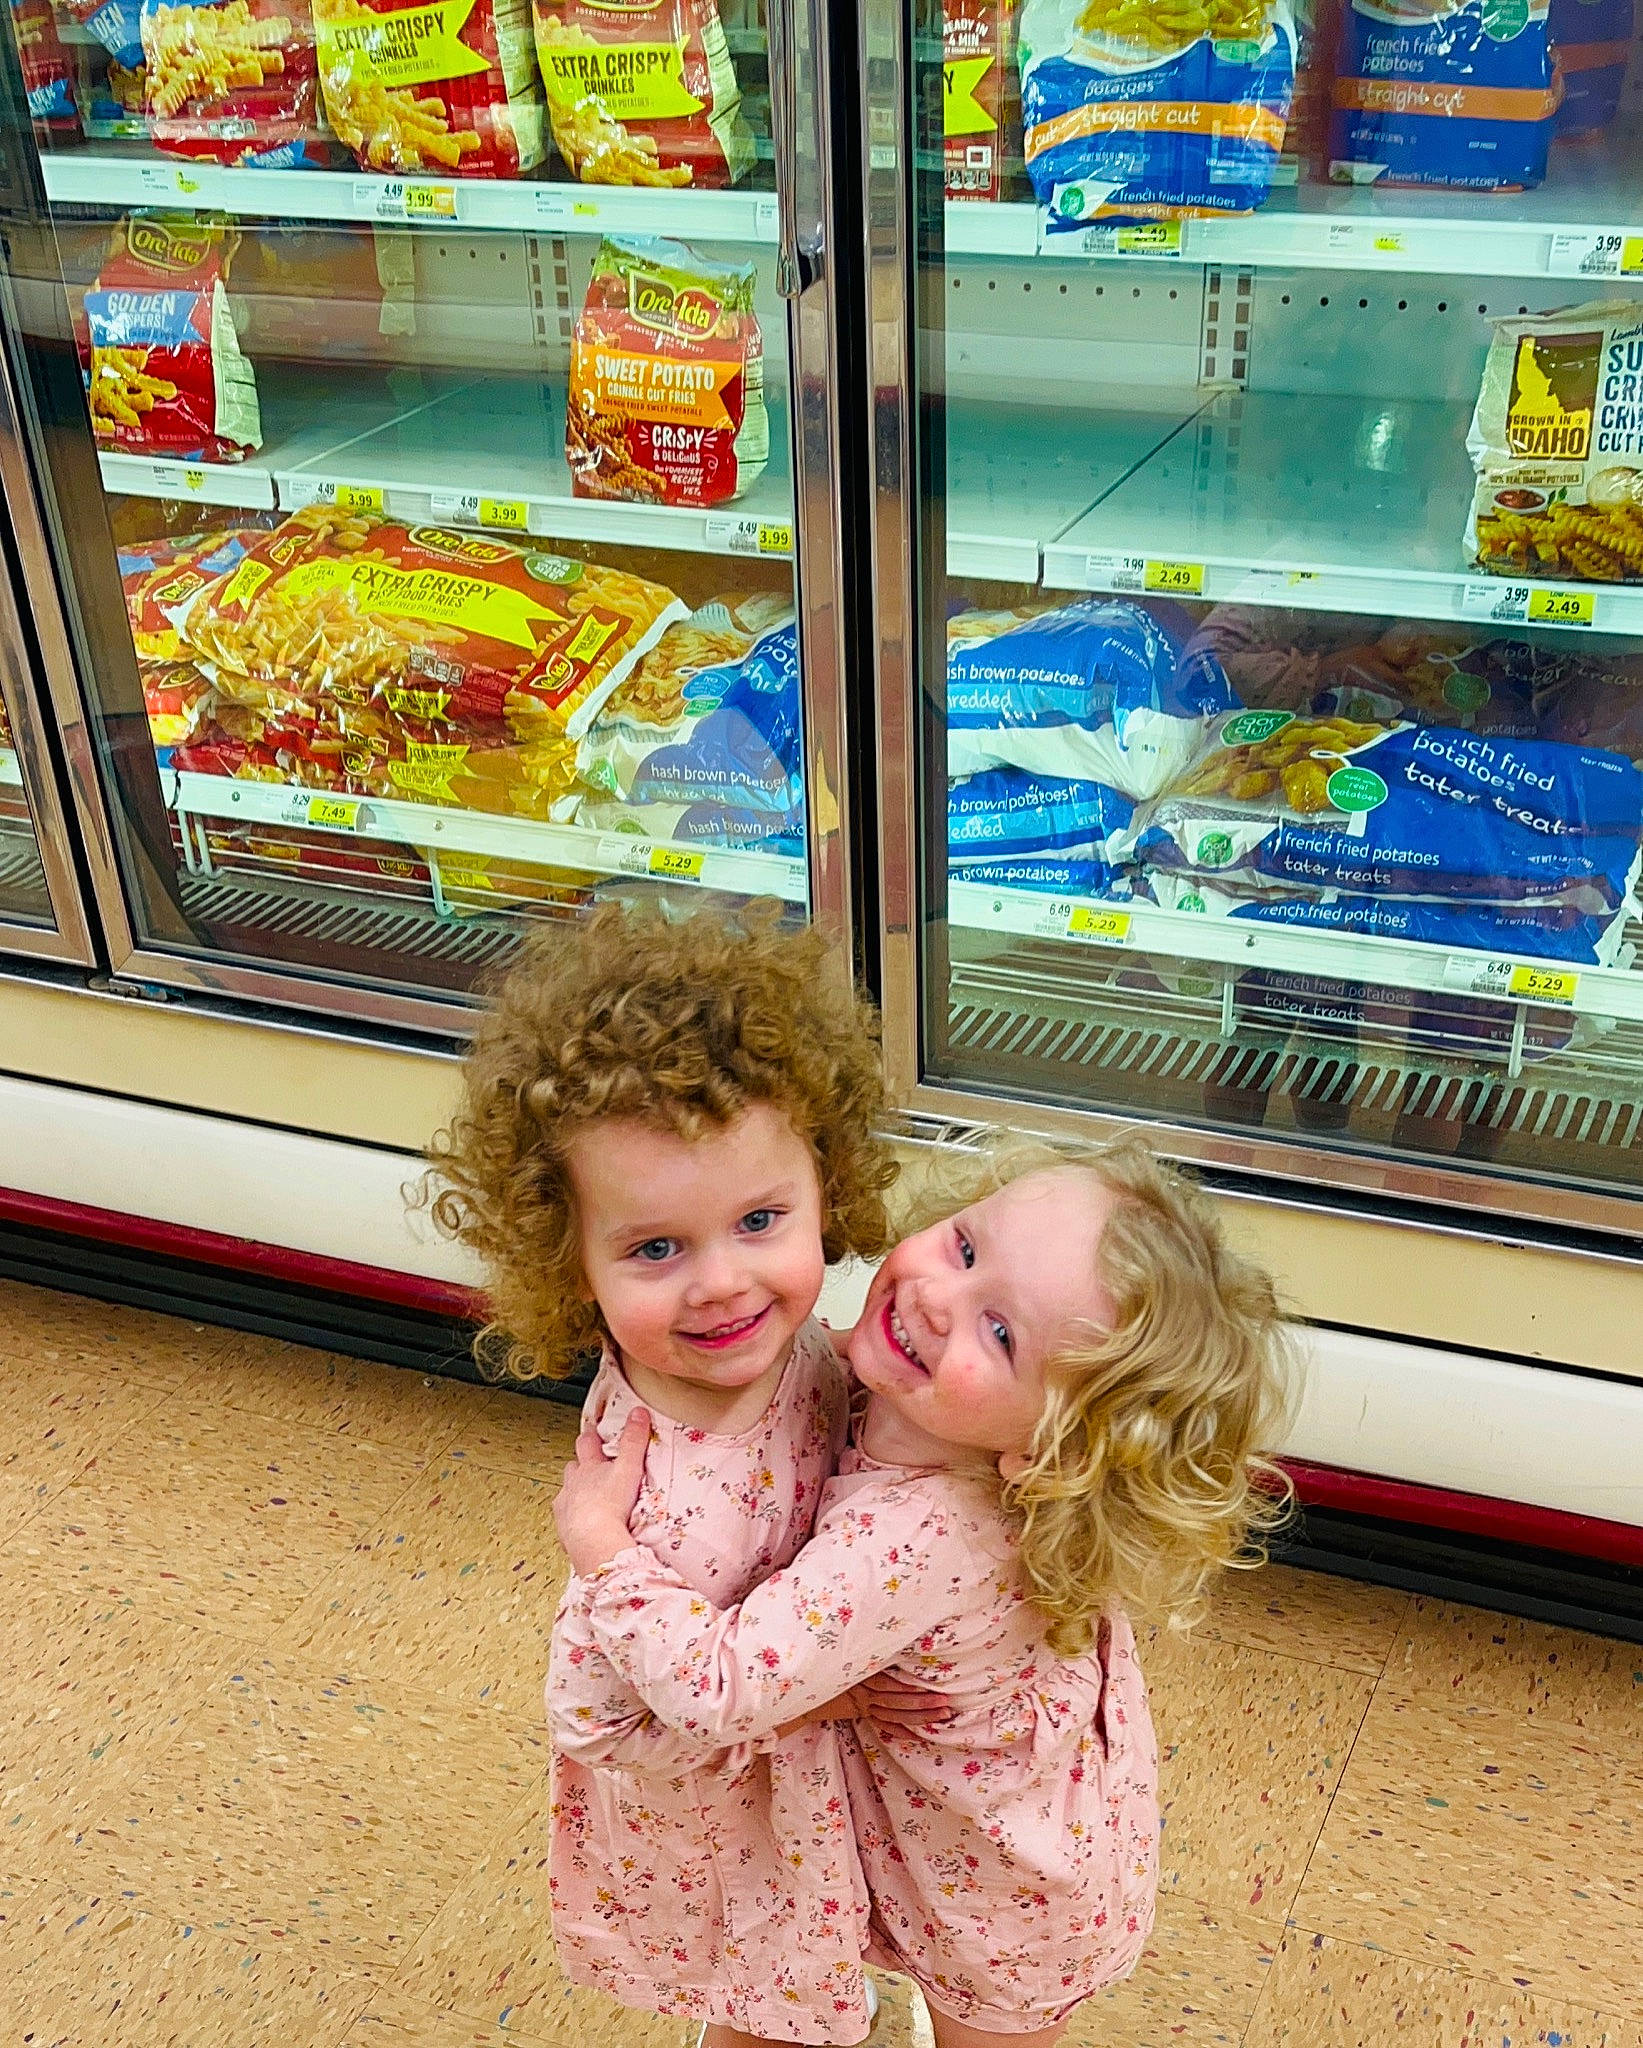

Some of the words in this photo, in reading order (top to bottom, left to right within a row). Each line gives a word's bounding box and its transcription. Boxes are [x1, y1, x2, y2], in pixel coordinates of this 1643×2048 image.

[385, 12, 445, 43] CRISPY
[958, 34, 980, 46] MIN
[1366, 34, 1410, 52] french
[369, 42, 418, 64] CRINKLES
[552, 54, 601, 80] EXTRA
[605, 51, 672, 76] CRISPY
[1362, 57, 1425, 73] potatoes
[584, 78, 635, 95] CRINKLES
[1358, 82, 1430, 112] straight
[1433, 87, 1465, 109] cut
[1166, 104, 1201, 125] cut
[384, 183, 403, 196] 4.49
[1119, 189, 1157, 203] french
[1158, 190, 1185, 204] fried
[1186, 192, 1236, 208] potatoes
[406, 193, 433, 207] 3.99
[1596, 235, 1622, 251] 3.99
[108, 292, 176, 317] GOLDEN
[638, 288, 710, 329] Ore-Ida
[595, 354, 649, 385] SWEET
[651, 361, 715, 391] POTATO
[607, 382, 644, 400] CRINKLE
[647, 387, 666, 402] CUT
[669, 390, 696, 406] FRIES
[1512, 414, 1555, 427] GROWN
[1559, 415, 1571, 425] IN
[652, 425, 704, 450] CRISPY
[1512, 427, 1584, 455] IDAHO
[1598, 432, 1634, 453] CUT
[653, 448, 660, 461] &
[318, 483, 335, 495] 4.49
[348, 493, 373, 507] 3.99
[460, 496, 478, 509] 4.49
[491, 507, 517, 521] 3.99
[739, 522, 757, 534] 4.49
[419, 530, 499, 559] Ore-Ida
[760, 530, 788, 545] 3.99
[351, 565, 415, 589] EXTRA
[418, 573, 499, 601] CRISPY
[1159, 570, 1190, 585] 2.49
[395, 590, 428, 601] FOOD
[428, 592, 466, 608] FRIES
[1504, 586, 1529, 601] 3.99
[1544, 600, 1580, 614] 2.49
[969, 663, 1016, 681] brown
[1017, 667, 1085, 686] potatoes
[650, 763, 681, 780] hash
[684, 764, 727, 782] brown
[1413, 735, 1516, 792] potatoes
[1500, 753, 1556, 791] fried
[1404, 762, 1480, 805] tater
[960, 797, 1006, 812] brown
[1009, 787, 1069, 812] potatoes
[1332, 788, 1378, 802] potatoes
[321, 804, 346, 818] 7.49
[688, 819, 720, 835] hash
[631, 844, 652, 855] 6.49
[1285, 832, 1332, 854] french
[1336, 837, 1370, 858] fried
[1372, 846, 1440, 866] potatoes
[663, 854, 692, 869] 5.29
[1284, 855, 1330, 876] tater
[1334, 864, 1392, 885] treats
[1049, 903, 1071, 917] 6.49
[1306, 905, 1342, 921] fried
[1344, 908, 1408, 928] potatoes
[1085, 917, 1117, 931] 5.29
[1487, 961, 1512, 975] 6.49
[1264, 970, 1310, 991] french
[1313, 977, 1346, 996] fried
[1349, 982, 1412, 1006] potatoes
[1527, 975, 1563, 991] 5.29
[1263, 992, 1305, 1014] tater
[1312, 1000, 1366, 1022] treats
